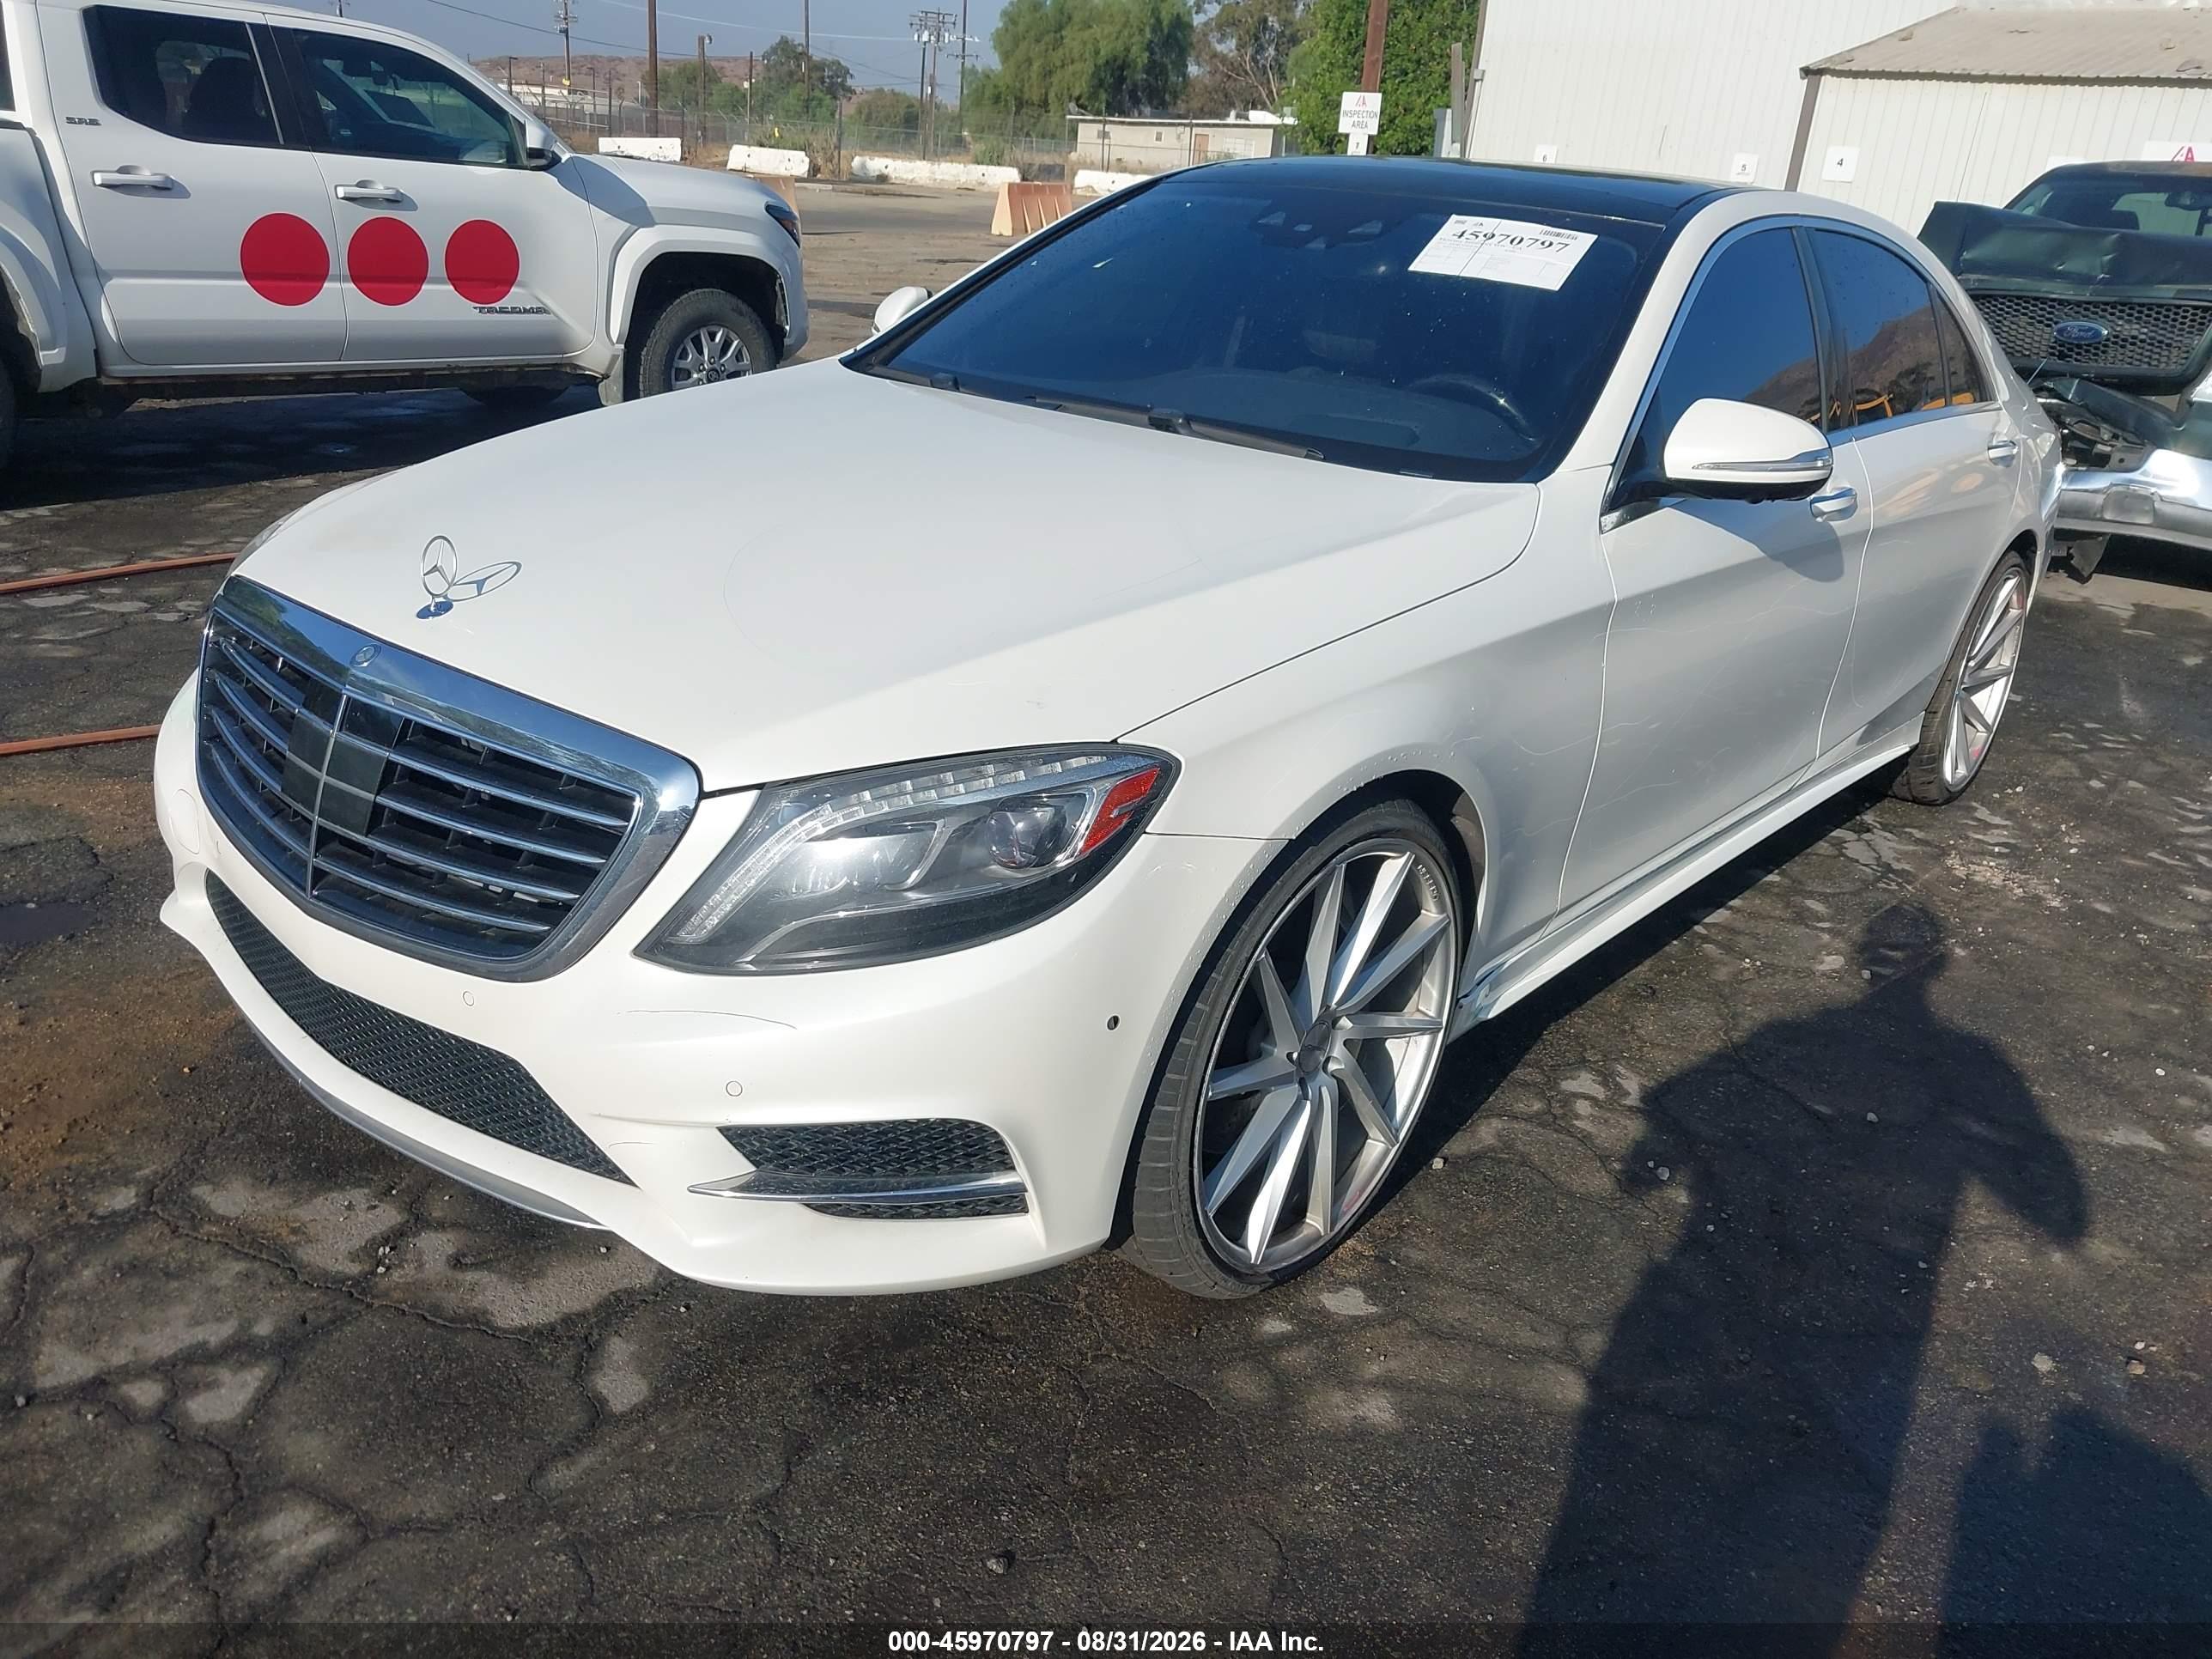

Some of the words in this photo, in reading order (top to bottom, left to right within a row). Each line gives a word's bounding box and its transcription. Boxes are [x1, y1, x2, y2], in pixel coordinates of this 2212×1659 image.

[1342, 109, 1379, 119] INSPECTION
[1352, 120, 1369, 130] AREA
[1837, 157, 1844, 167] 4
[1452, 228, 1571, 253] 45970797
[472, 306, 551, 315] TACOMA
